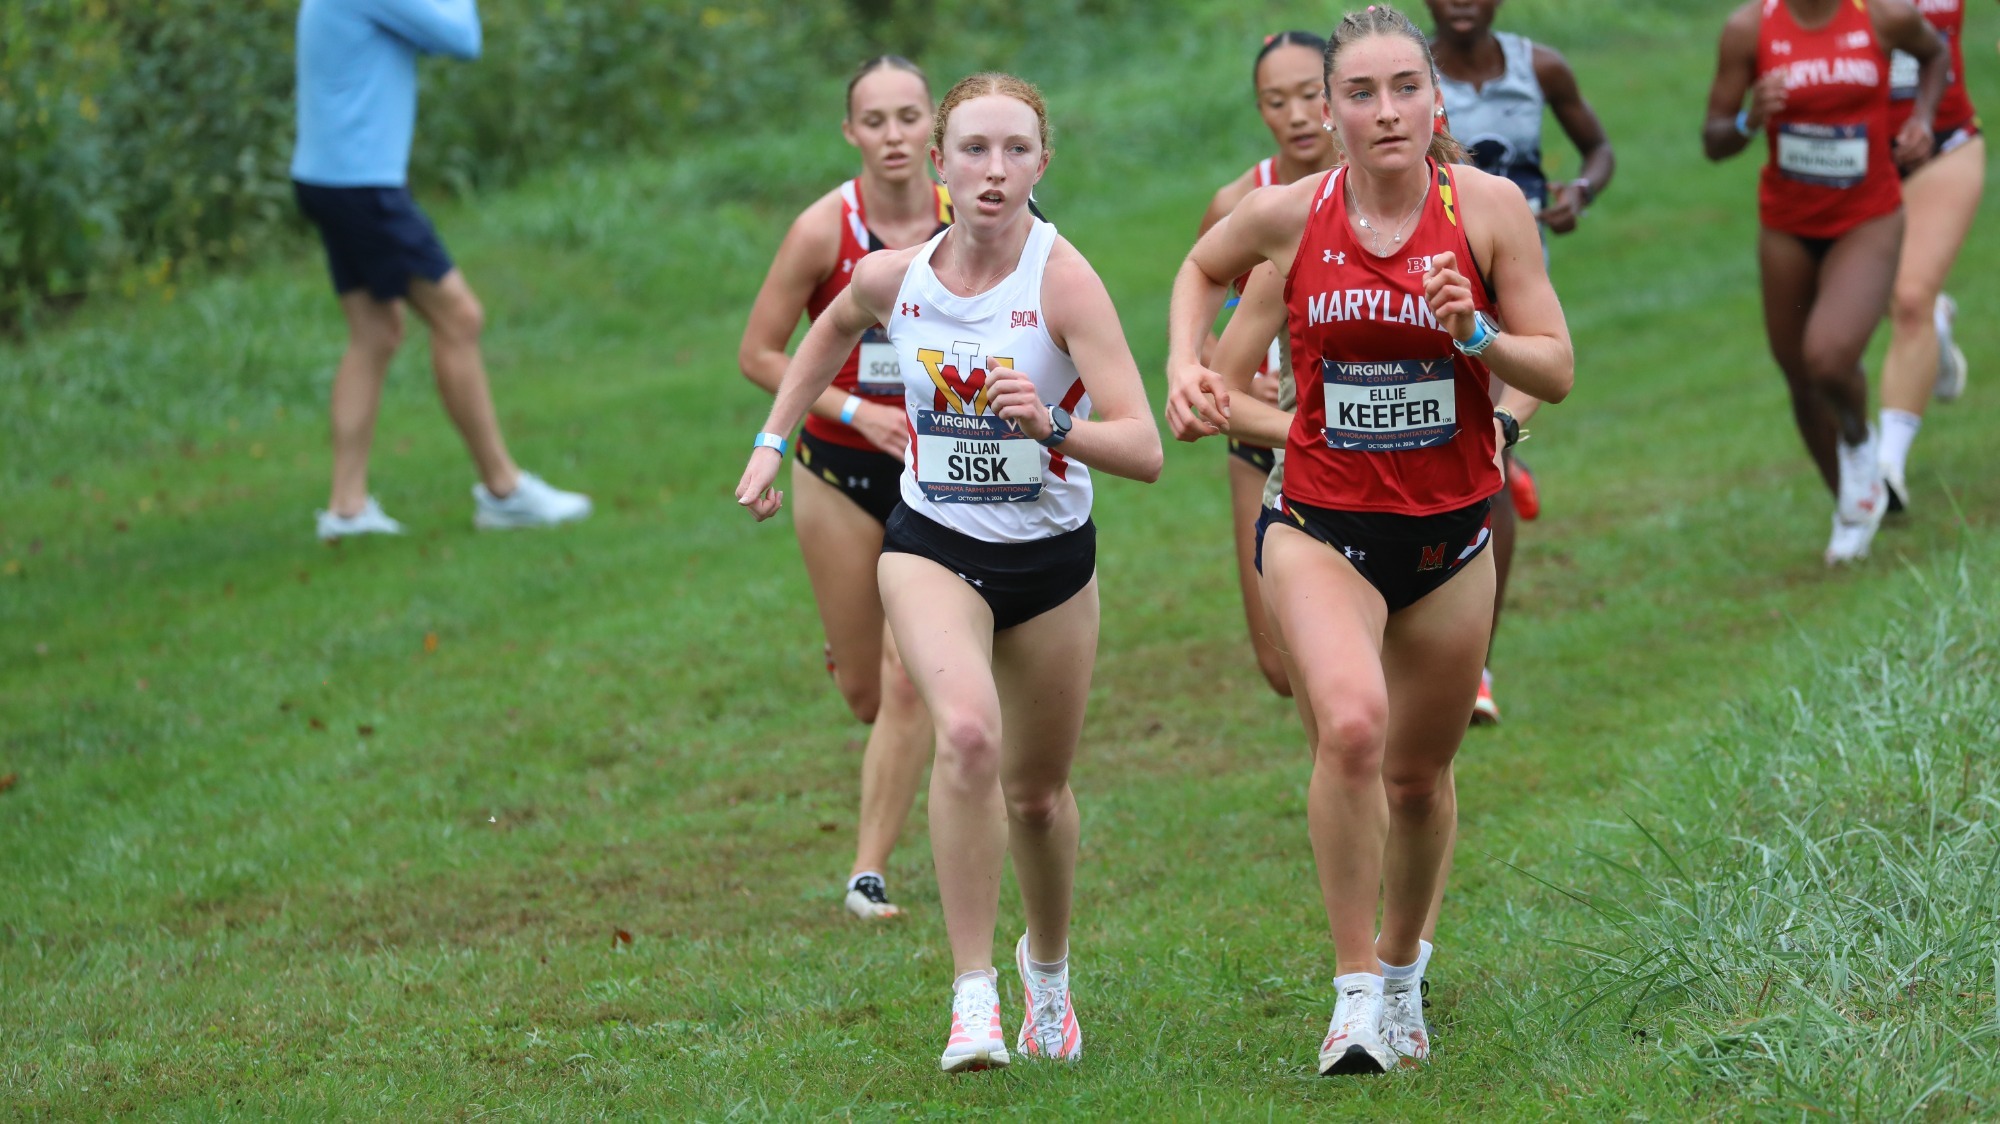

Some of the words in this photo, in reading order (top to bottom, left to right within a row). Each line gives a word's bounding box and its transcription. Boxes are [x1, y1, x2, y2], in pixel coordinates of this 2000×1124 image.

[1337, 363, 1405, 376] VIRGINIA
[1336, 375, 1363, 383] CROSS
[1366, 375, 1409, 383] COUNTRY
[1369, 387, 1407, 401] ELLIE
[1339, 399, 1440, 429] KEEFER
[930, 413, 991, 430] VIRGINIA
[929, 425, 954, 434] CROSS
[956, 429, 995, 437] COUNTRY
[1336, 431, 1373, 440] PANORAMA
[1398, 428, 1444, 439] INVITATIONAL
[953, 440, 1000, 455] JILLIAN
[948, 455, 1011, 482] SISK
[927, 484, 964, 492] PANORAMA
